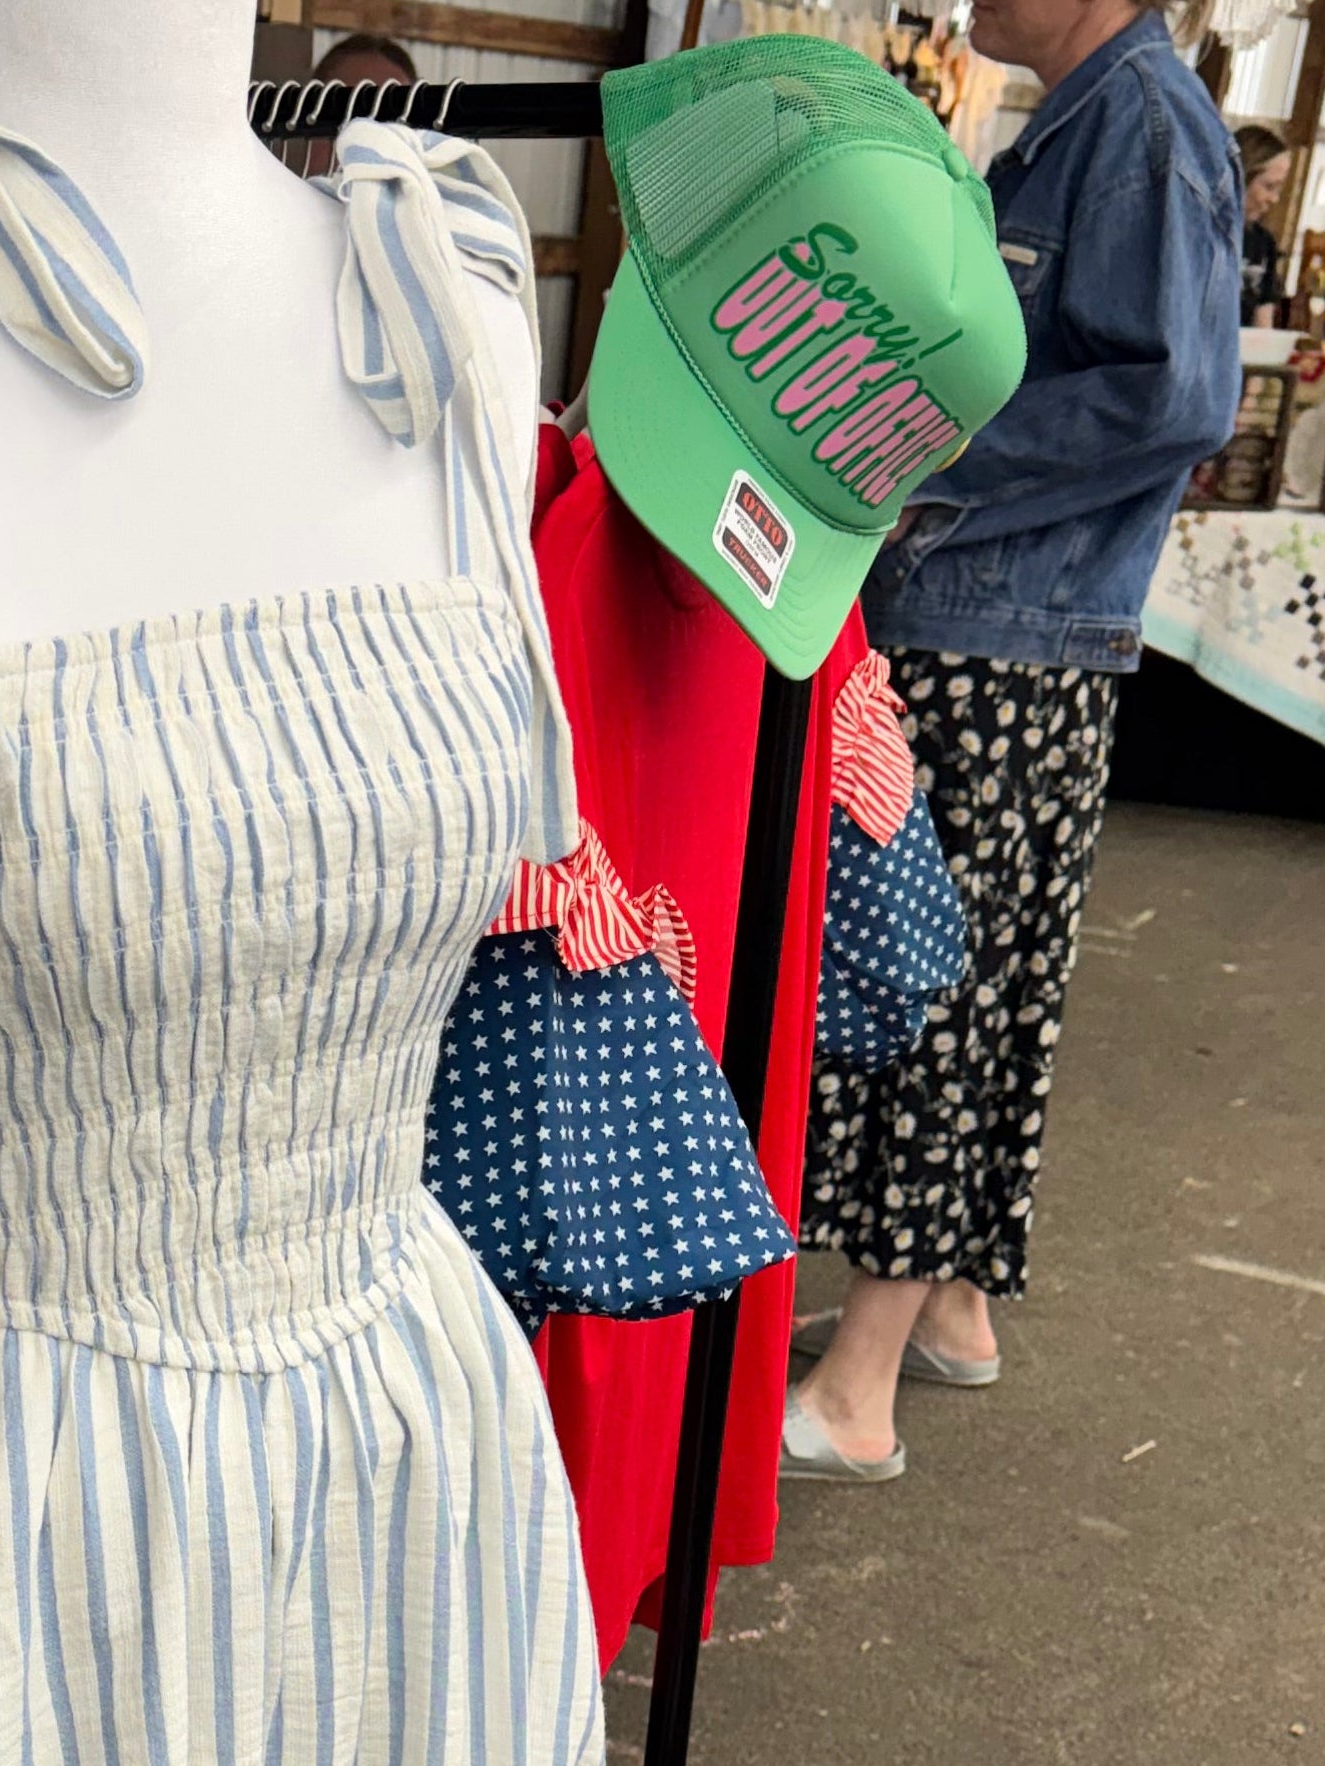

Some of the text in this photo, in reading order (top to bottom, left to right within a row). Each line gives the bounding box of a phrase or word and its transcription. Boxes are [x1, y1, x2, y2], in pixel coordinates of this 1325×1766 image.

[776, 221, 964, 370] Sorry!
[709, 237, 964, 509] OUT OF OFFICE
[728, 536, 768, 587] TRUCKER
[742, 492, 783, 547] OTTO
